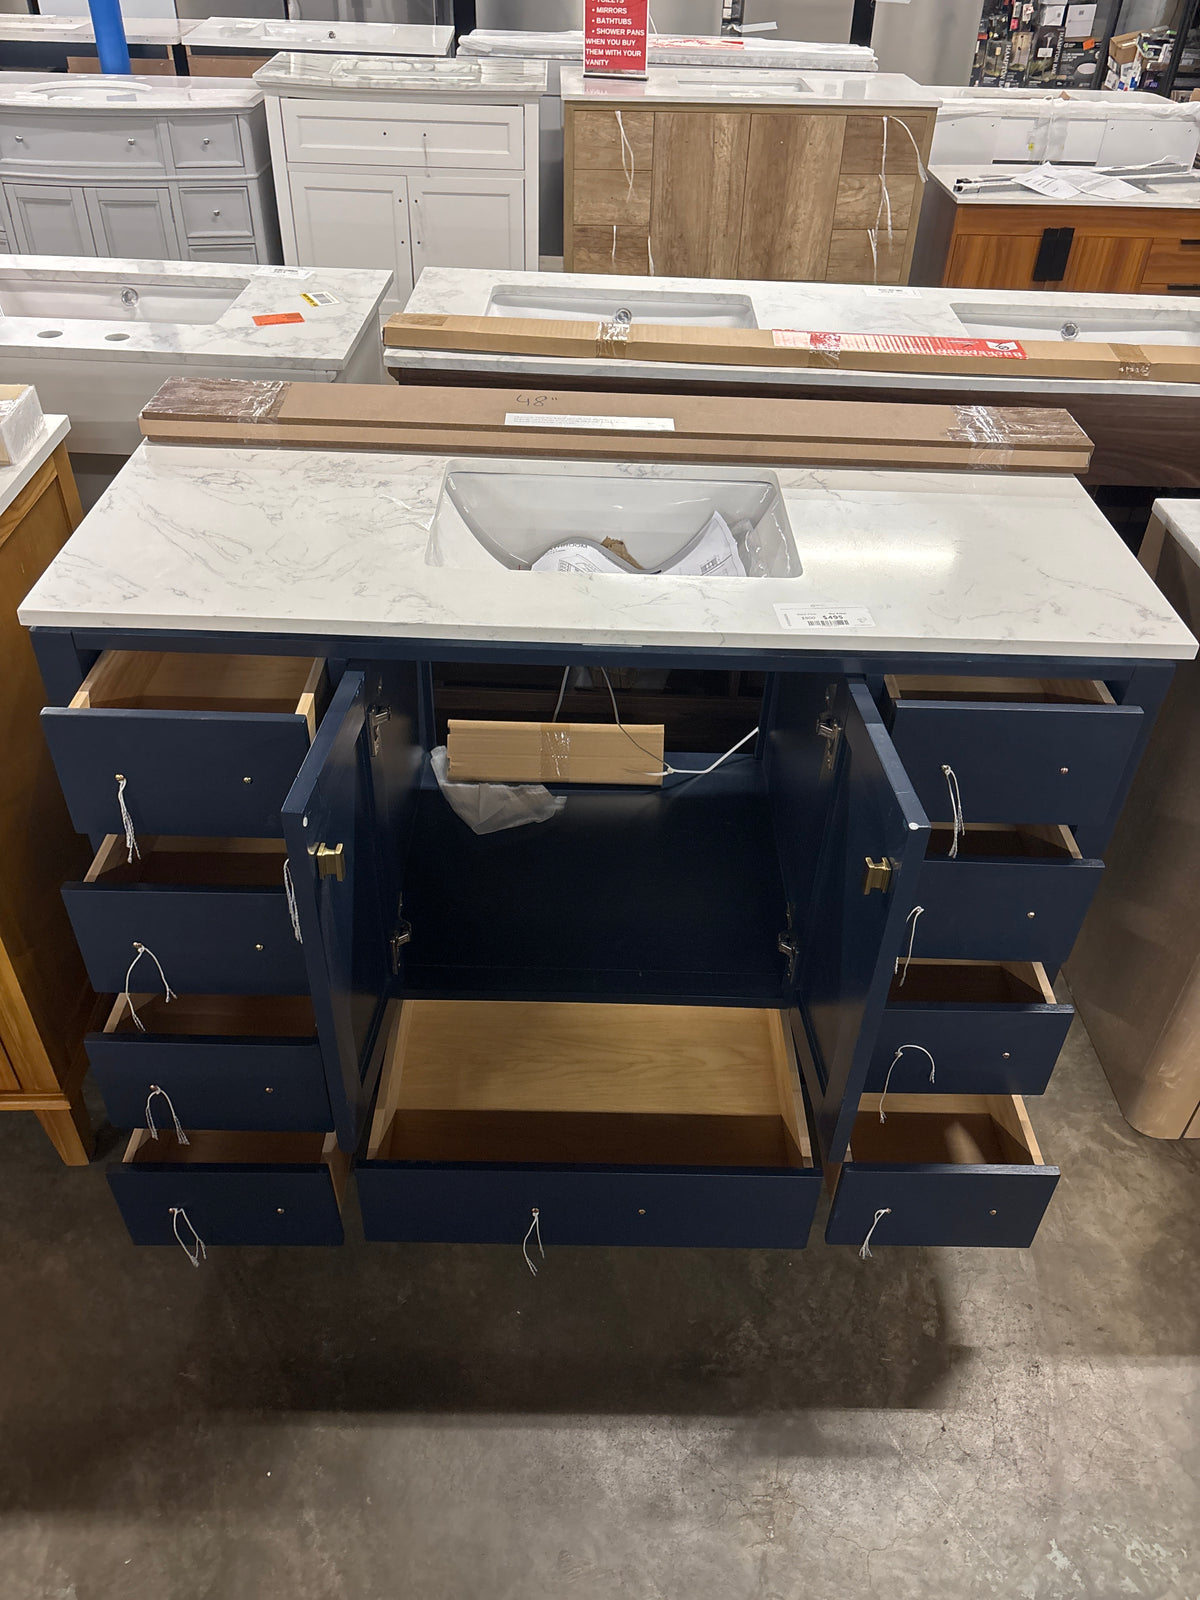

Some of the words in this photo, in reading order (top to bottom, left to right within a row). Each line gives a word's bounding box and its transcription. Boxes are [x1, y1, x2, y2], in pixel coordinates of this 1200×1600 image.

[596, 27, 626, 35] SHOWER
[626, 28, 645, 36] PANS
[1000, 45, 1012, 78] HAMPTON
[1053, 32, 1064, 63] HAMPTON
